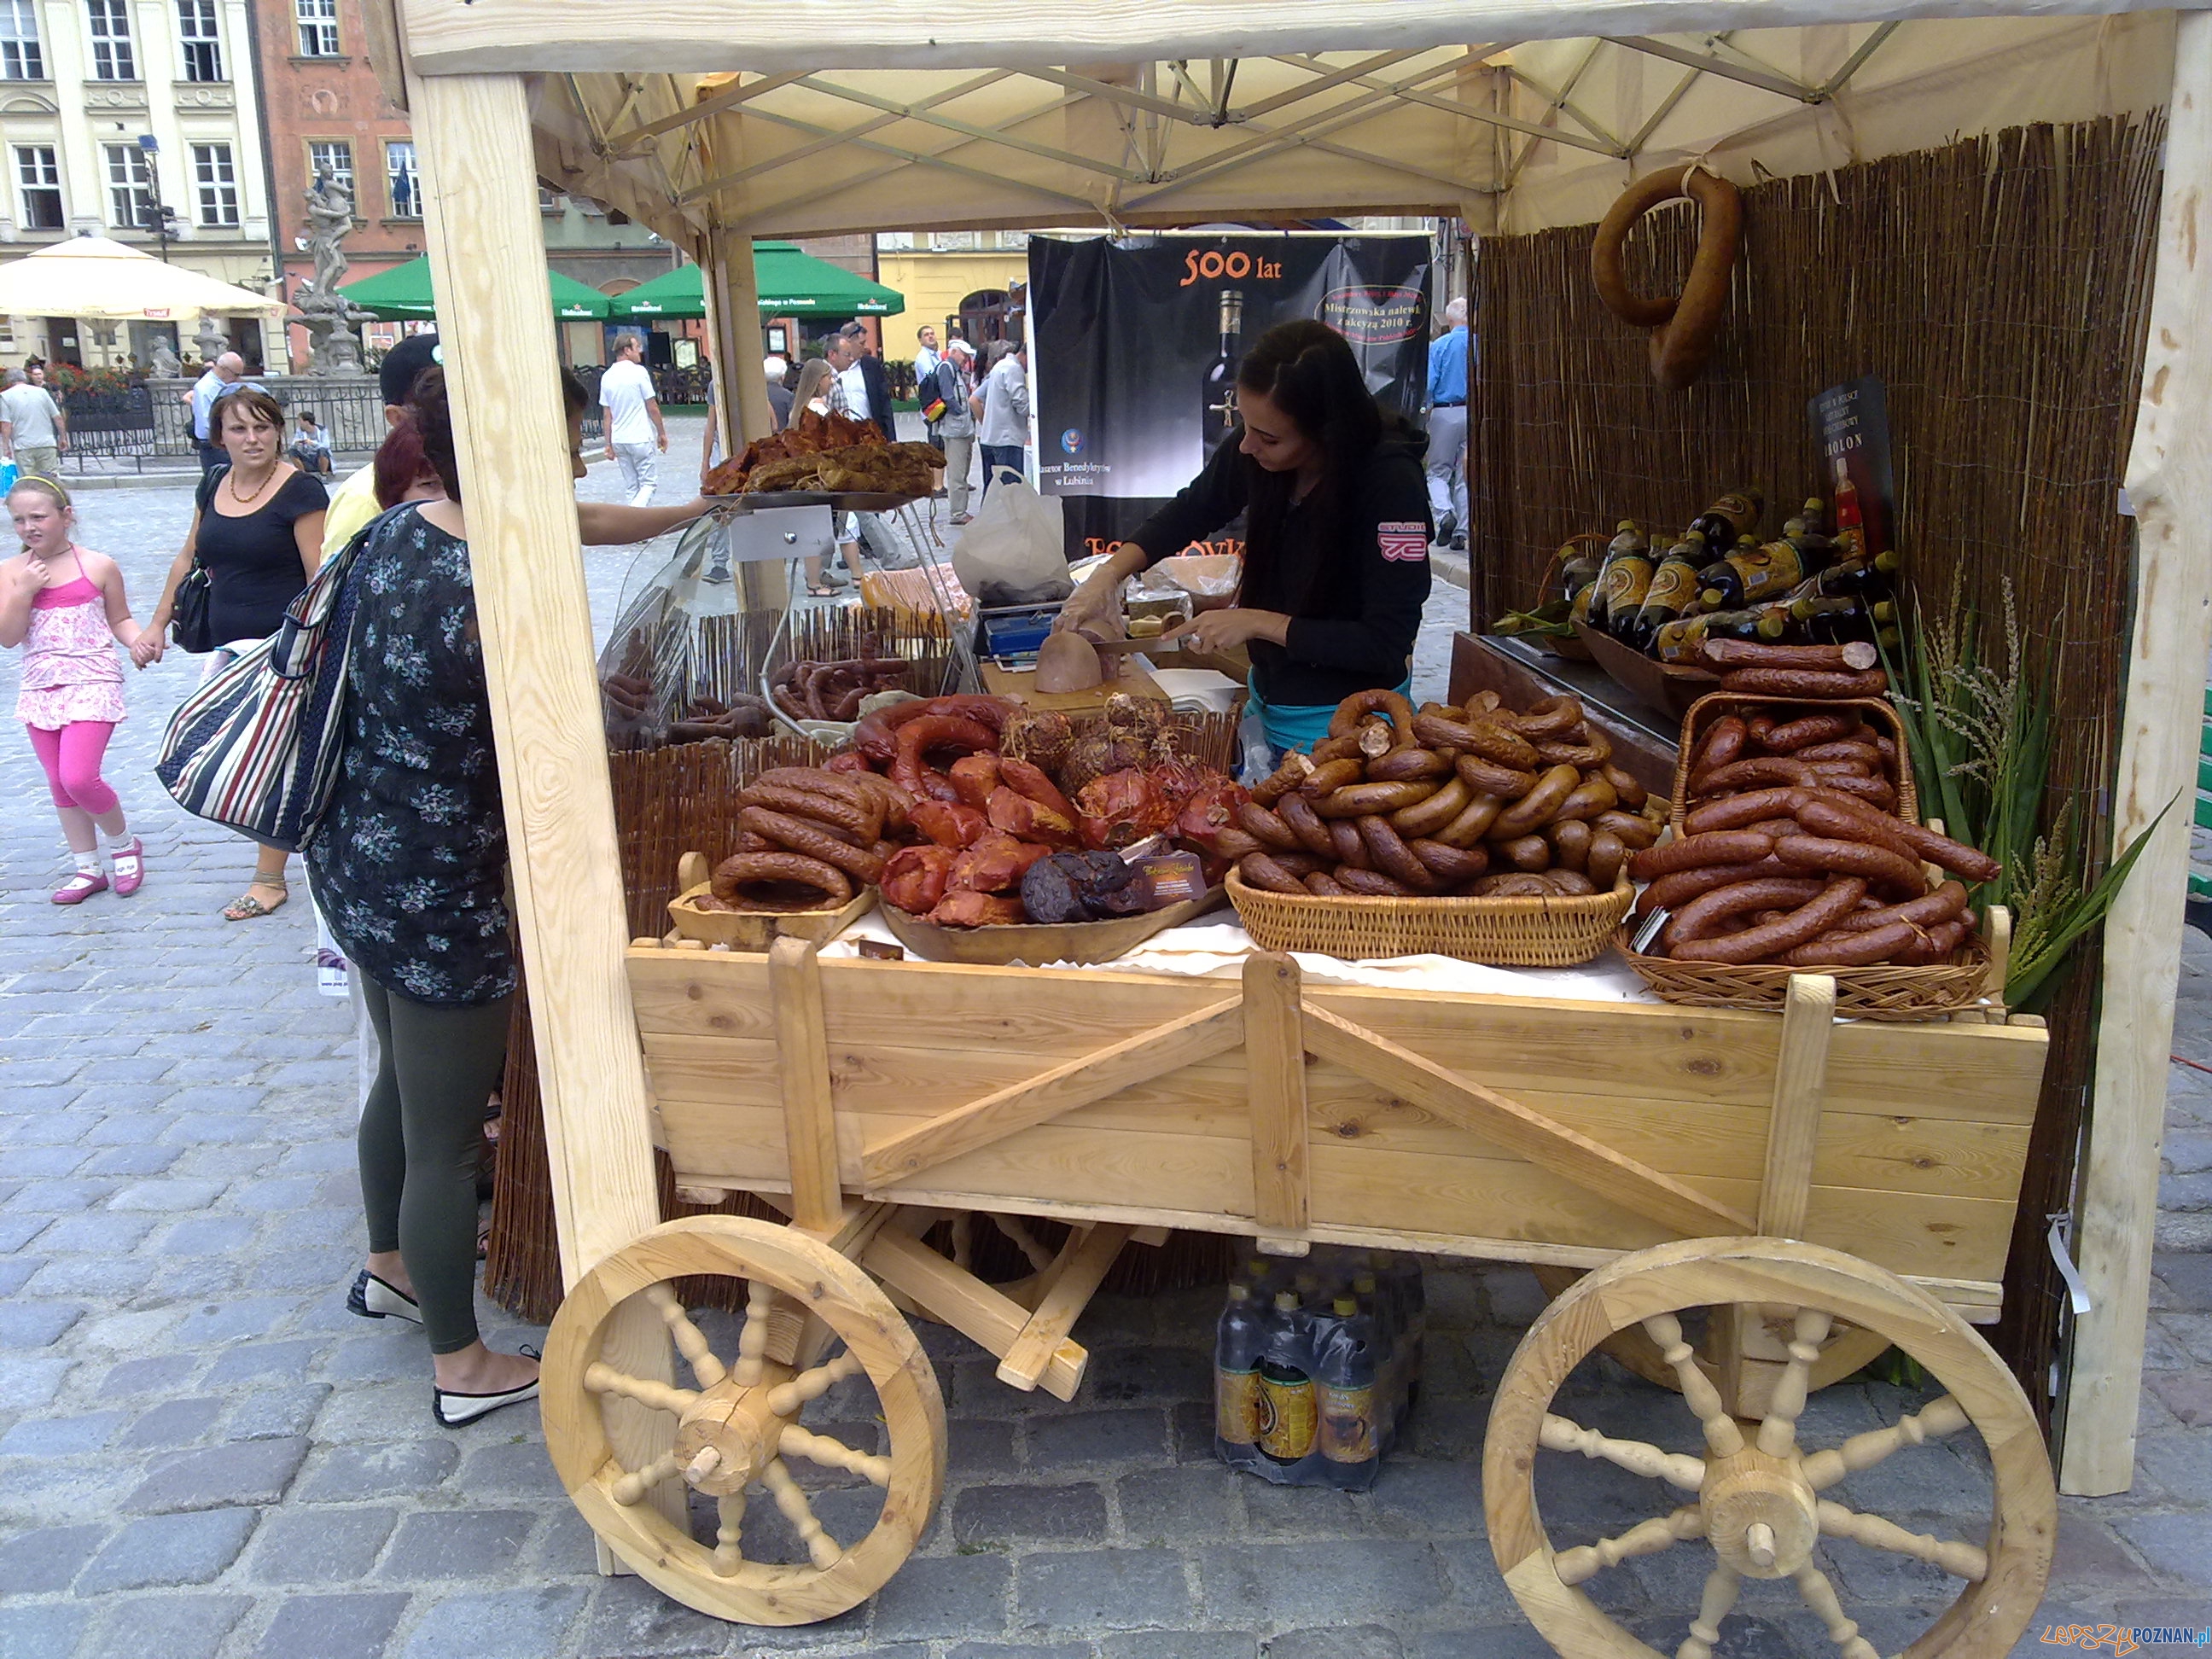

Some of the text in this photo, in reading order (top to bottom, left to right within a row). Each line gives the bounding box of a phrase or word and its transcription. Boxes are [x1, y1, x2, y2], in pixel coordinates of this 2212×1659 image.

[1179, 249, 1282, 288] 500 lat
[1324, 303, 1386, 317] Mistrzowska
[1345, 317, 1378, 330] akcyzą
[1380, 317, 1404, 329] 2010
